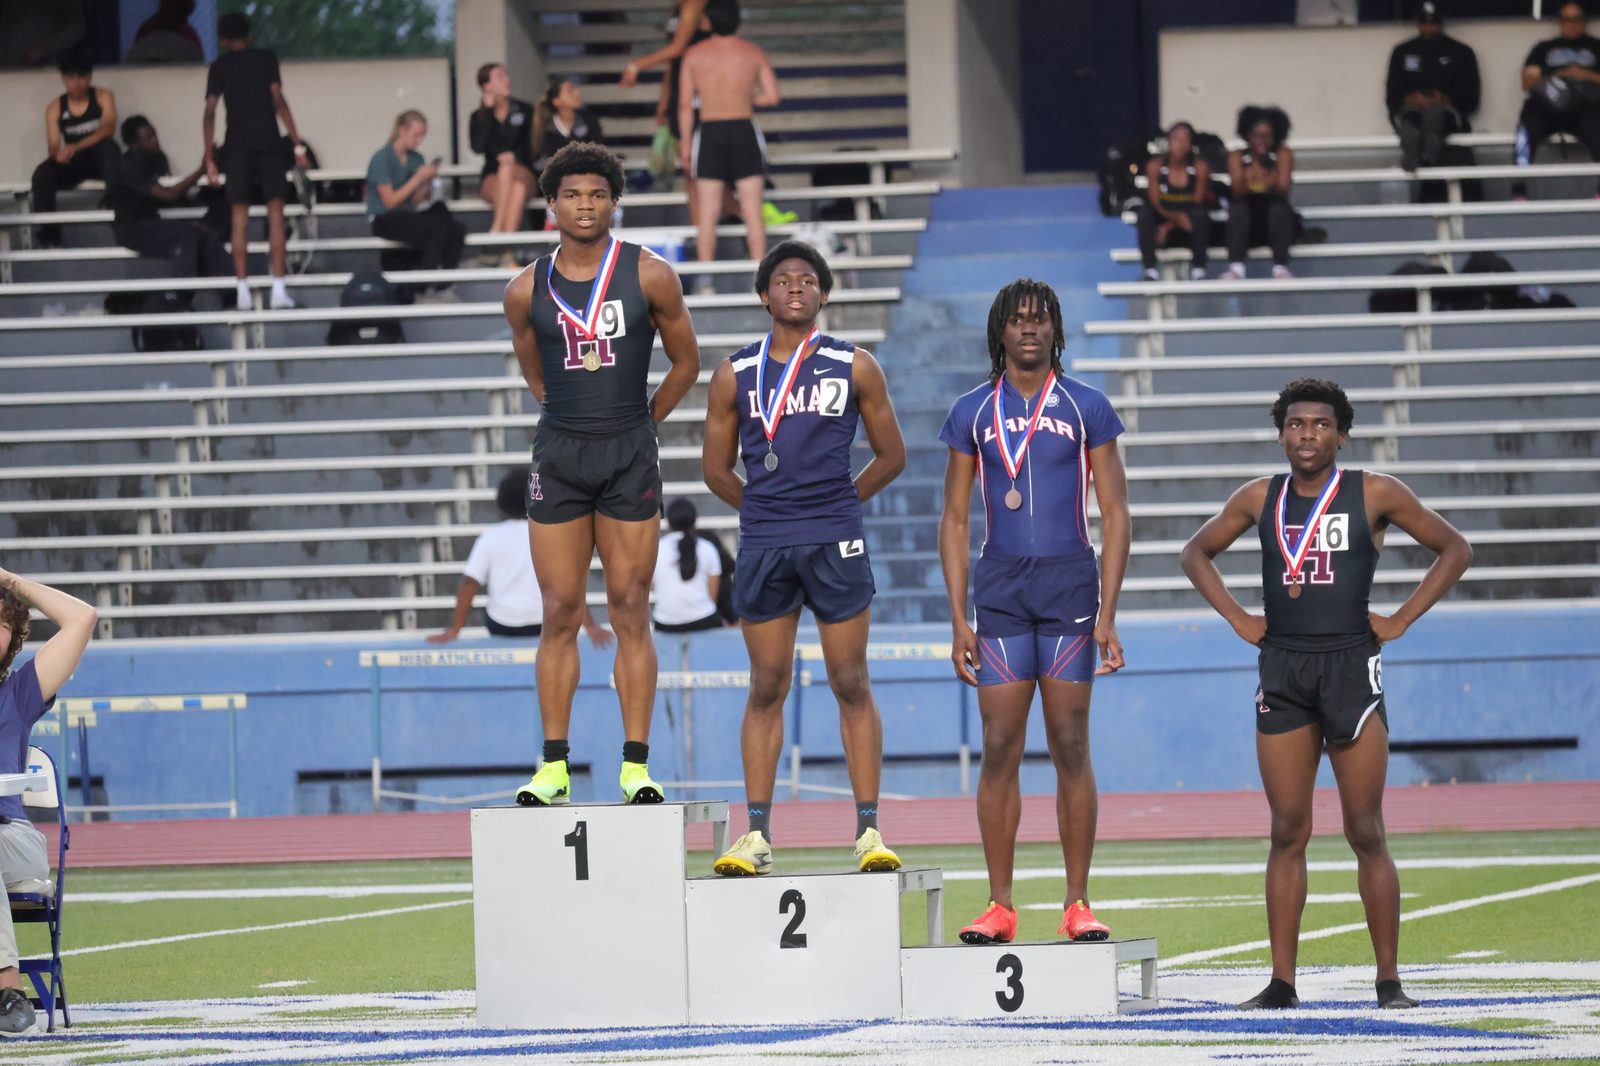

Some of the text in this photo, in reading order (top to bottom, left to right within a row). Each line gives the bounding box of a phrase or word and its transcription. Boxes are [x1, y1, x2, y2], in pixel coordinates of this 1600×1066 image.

[601, 303, 619, 337] 9
[747, 384, 821, 419] LAMA
[824, 380, 842, 415] 2
[983, 415, 1076, 444] LAMAR
[1325, 515, 1343, 550] 6
[438, 651, 515, 665] ATHLETICS
[564, 821, 589, 880] 1
[779, 889, 807, 949] 2
[995, 953, 1025, 1013] 3
